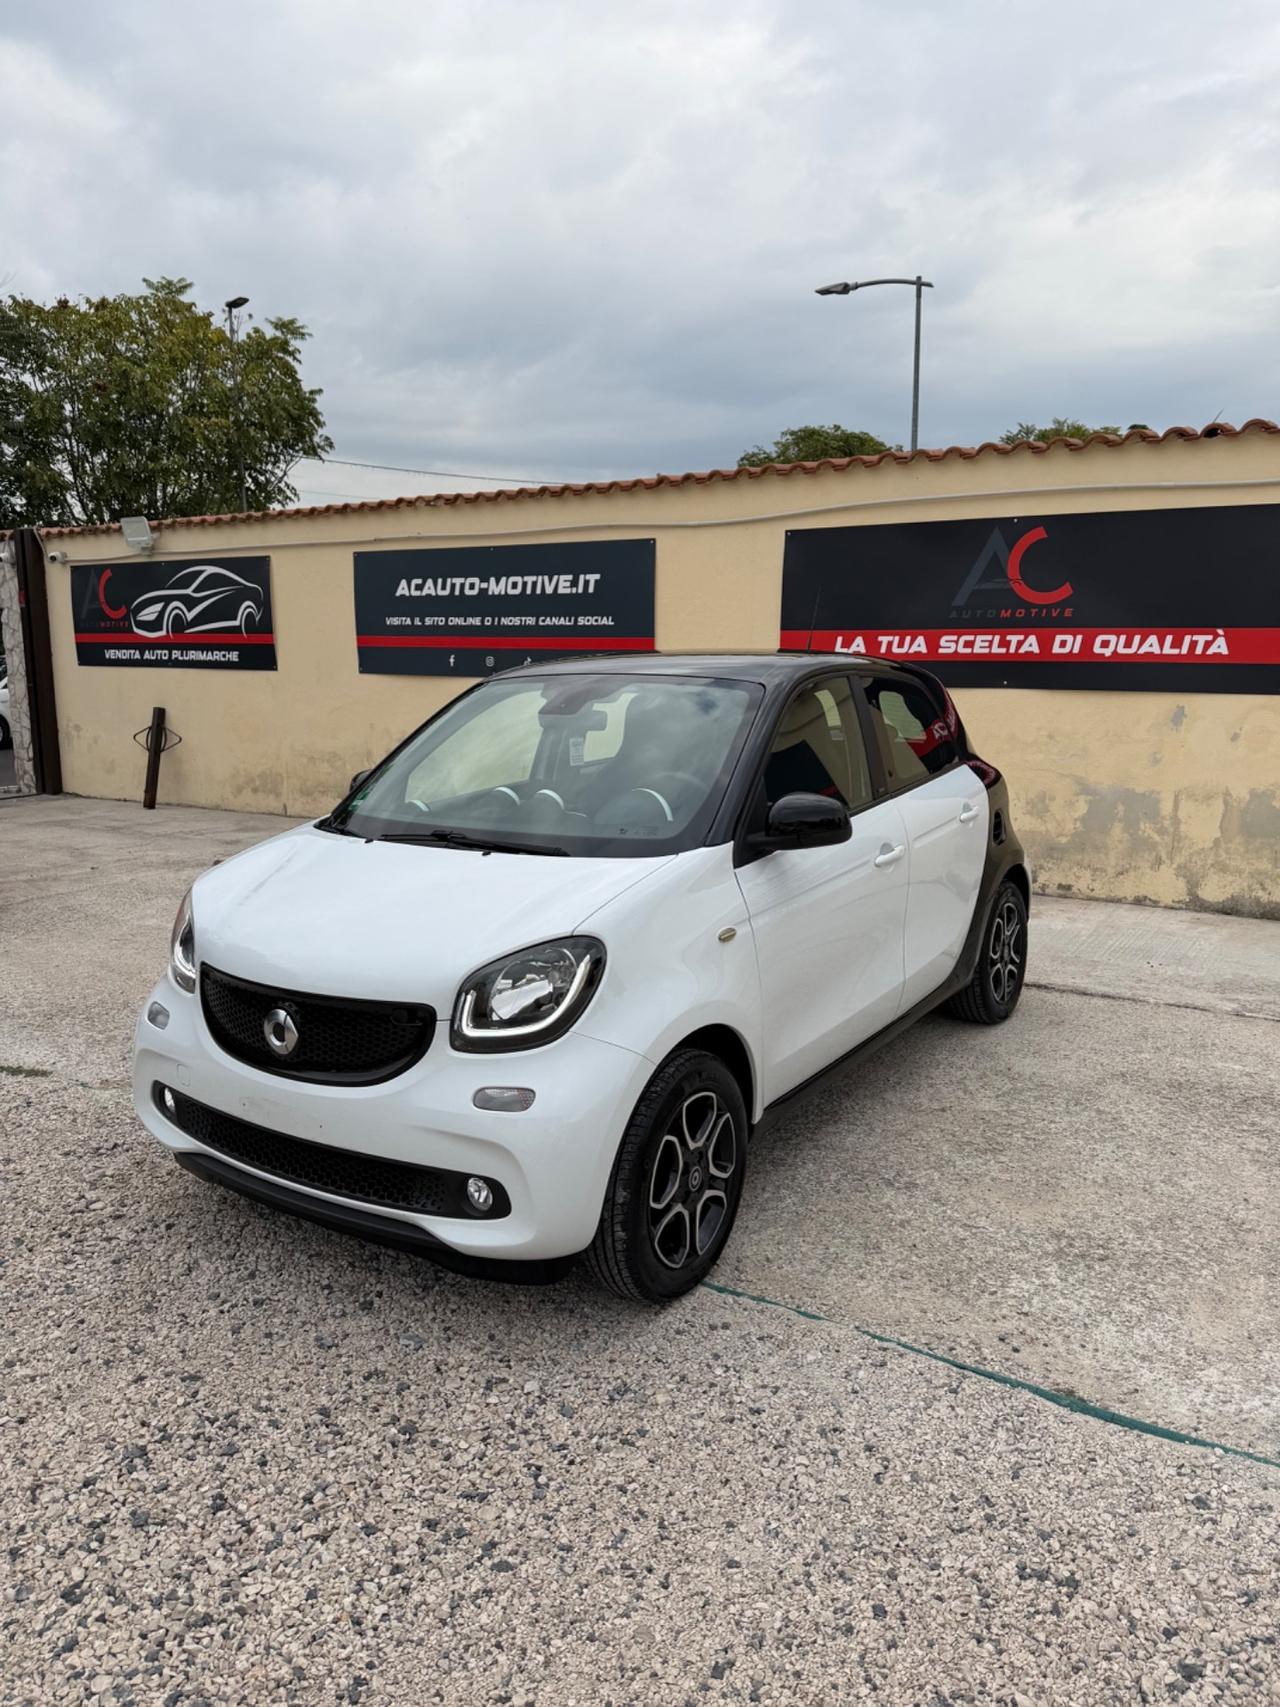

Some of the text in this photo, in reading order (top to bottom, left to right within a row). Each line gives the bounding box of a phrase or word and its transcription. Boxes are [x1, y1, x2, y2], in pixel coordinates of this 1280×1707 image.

[952, 525, 1074, 605] AC
[395, 573, 601, 597] ACAUTO-MOTIVE.IT
[385, 616, 412, 626] VISITA
[413, 616, 423, 626] IL
[424, 616, 446, 626] SITO
[447, 616, 482, 626] ONLINE
[500, 616, 537, 626] NOSTRI
[538, 616, 575, 626] CANALI
[576, 615, 615, 626] SOCIAL
[948, 607, 1074, 619] AUTOMOTIVE
[835, 628, 1230, 657] LA TUA SCELTA DI QUALITÀ
[104, 648, 240, 662] VENDITA AUTO PLURIMARCHE
